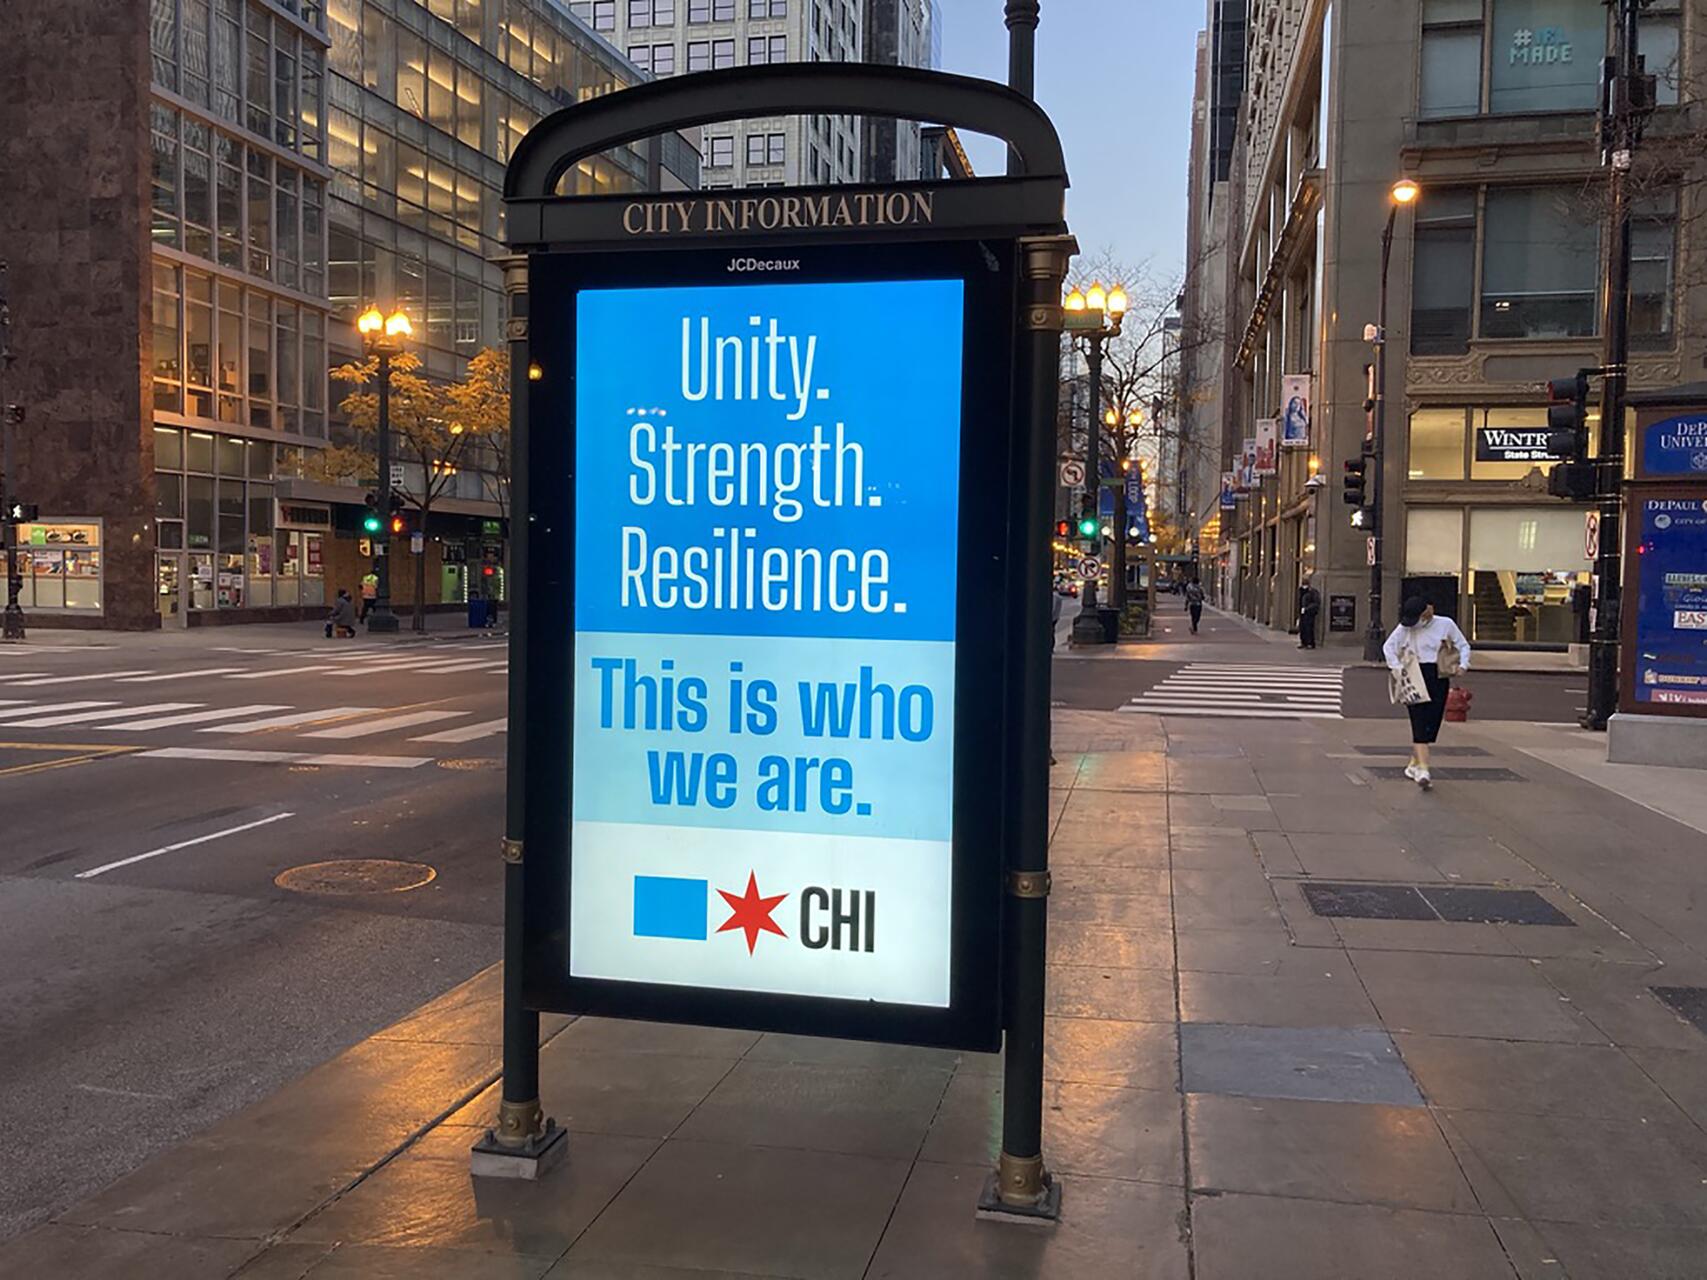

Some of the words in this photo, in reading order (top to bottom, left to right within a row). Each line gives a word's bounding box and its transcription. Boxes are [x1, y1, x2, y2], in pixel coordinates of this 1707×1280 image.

[1509, 45, 1573, 64] MADE
[623, 200, 696, 234] CITY
[705, 191, 934, 231] INFORMATION
[727, 258, 800, 272] JCDecaux
[681, 315, 830, 421] Unity.
[1484, 430, 1553, 446] WINTR
[1677, 422, 1707, 436] DEP
[629, 422, 882, 522] Strength.
[1504, 450, 1530, 459] State
[1648, 500, 1699, 510] DEPAUL
[621, 526, 907, 613] Resilience.
[591, 657, 708, 733] This
[729, 661, 778, 735] is
[798, 666, 934, 742] who
[647, 750, 738, 809] we
[757, 755, 872, 816] are.
[800, 886, 876, 953] CHI
